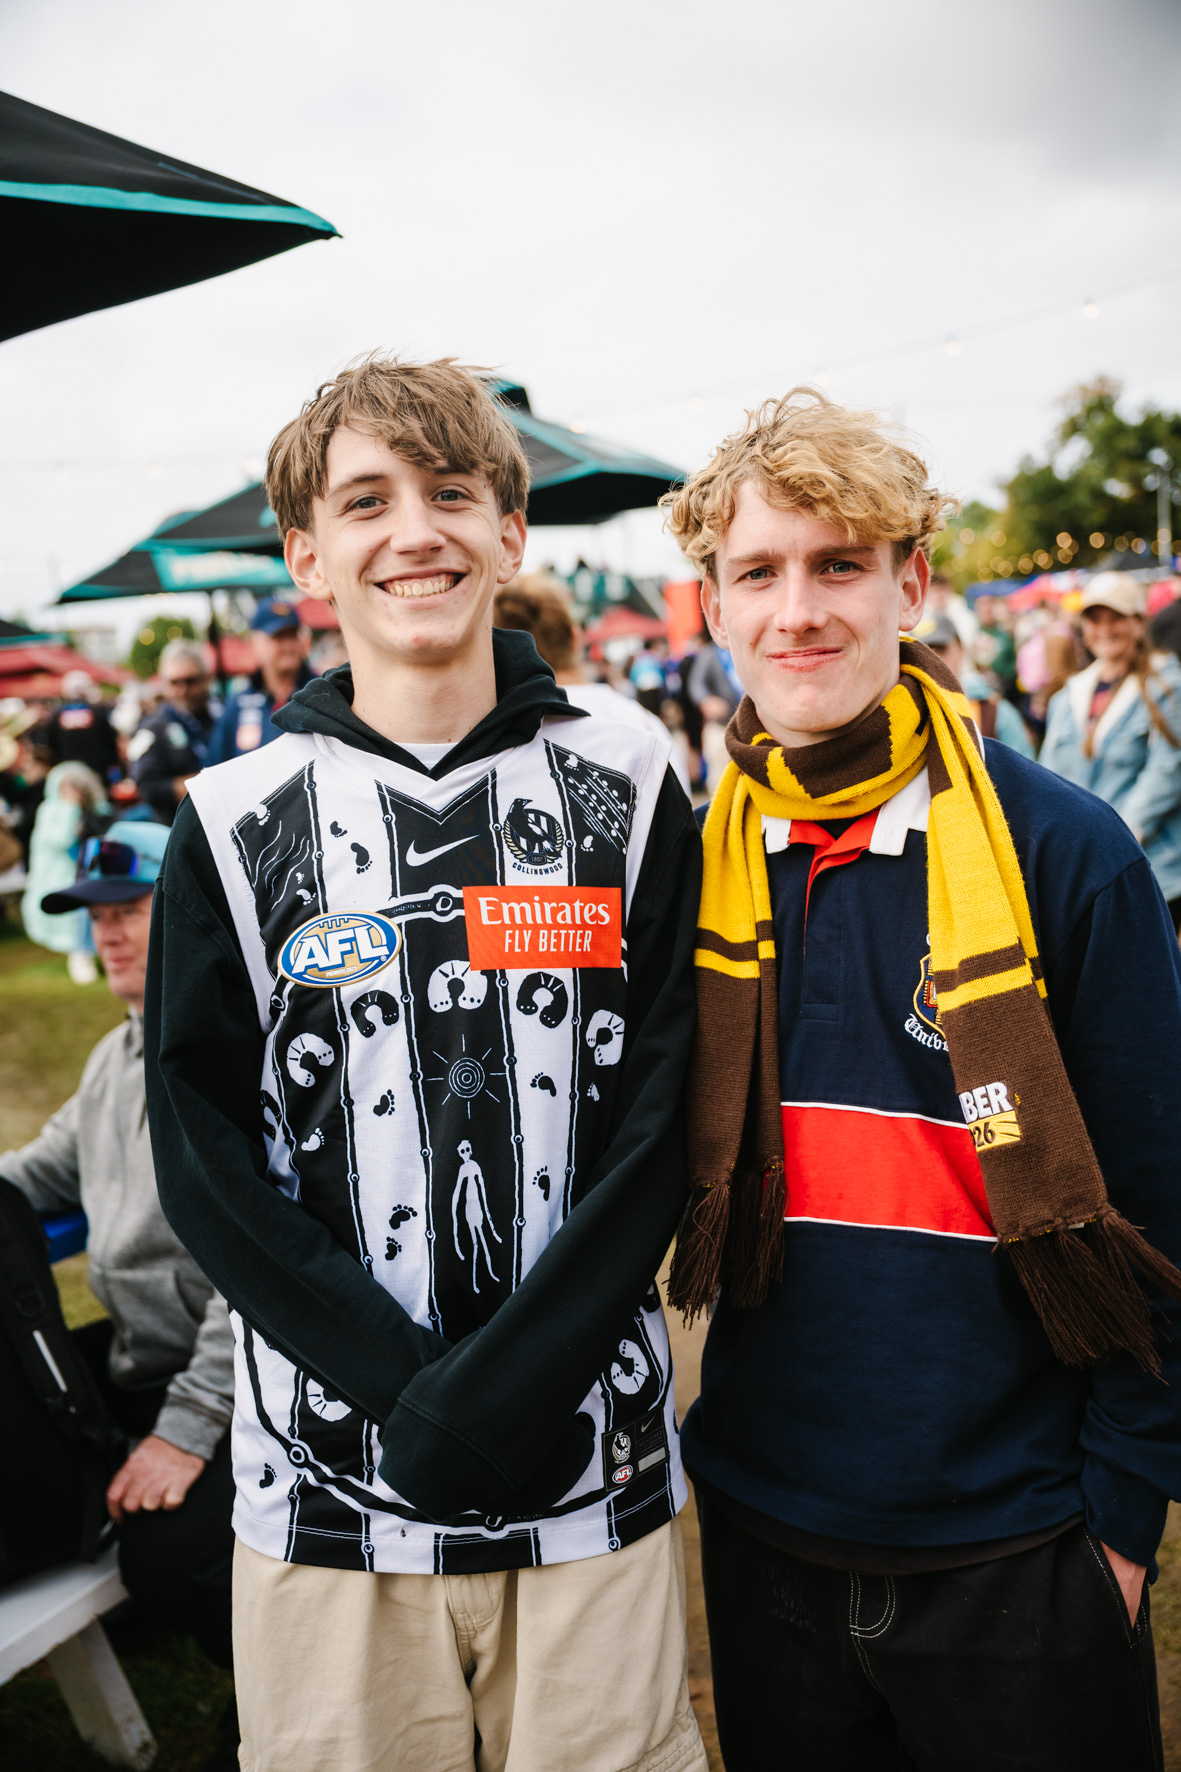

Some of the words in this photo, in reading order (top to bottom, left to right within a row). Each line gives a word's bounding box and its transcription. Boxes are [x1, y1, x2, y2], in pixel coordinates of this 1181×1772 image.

[512, 862, 563, 875] COLLINGWOOD
[477, 895, 611, 925] Emirates
[291, 924, 390, 975] AFL
[504, 929, 532, 953] FLY
[538, 929, 593, 952] BETTER
[616, 1469, 631, 1480] AFL
